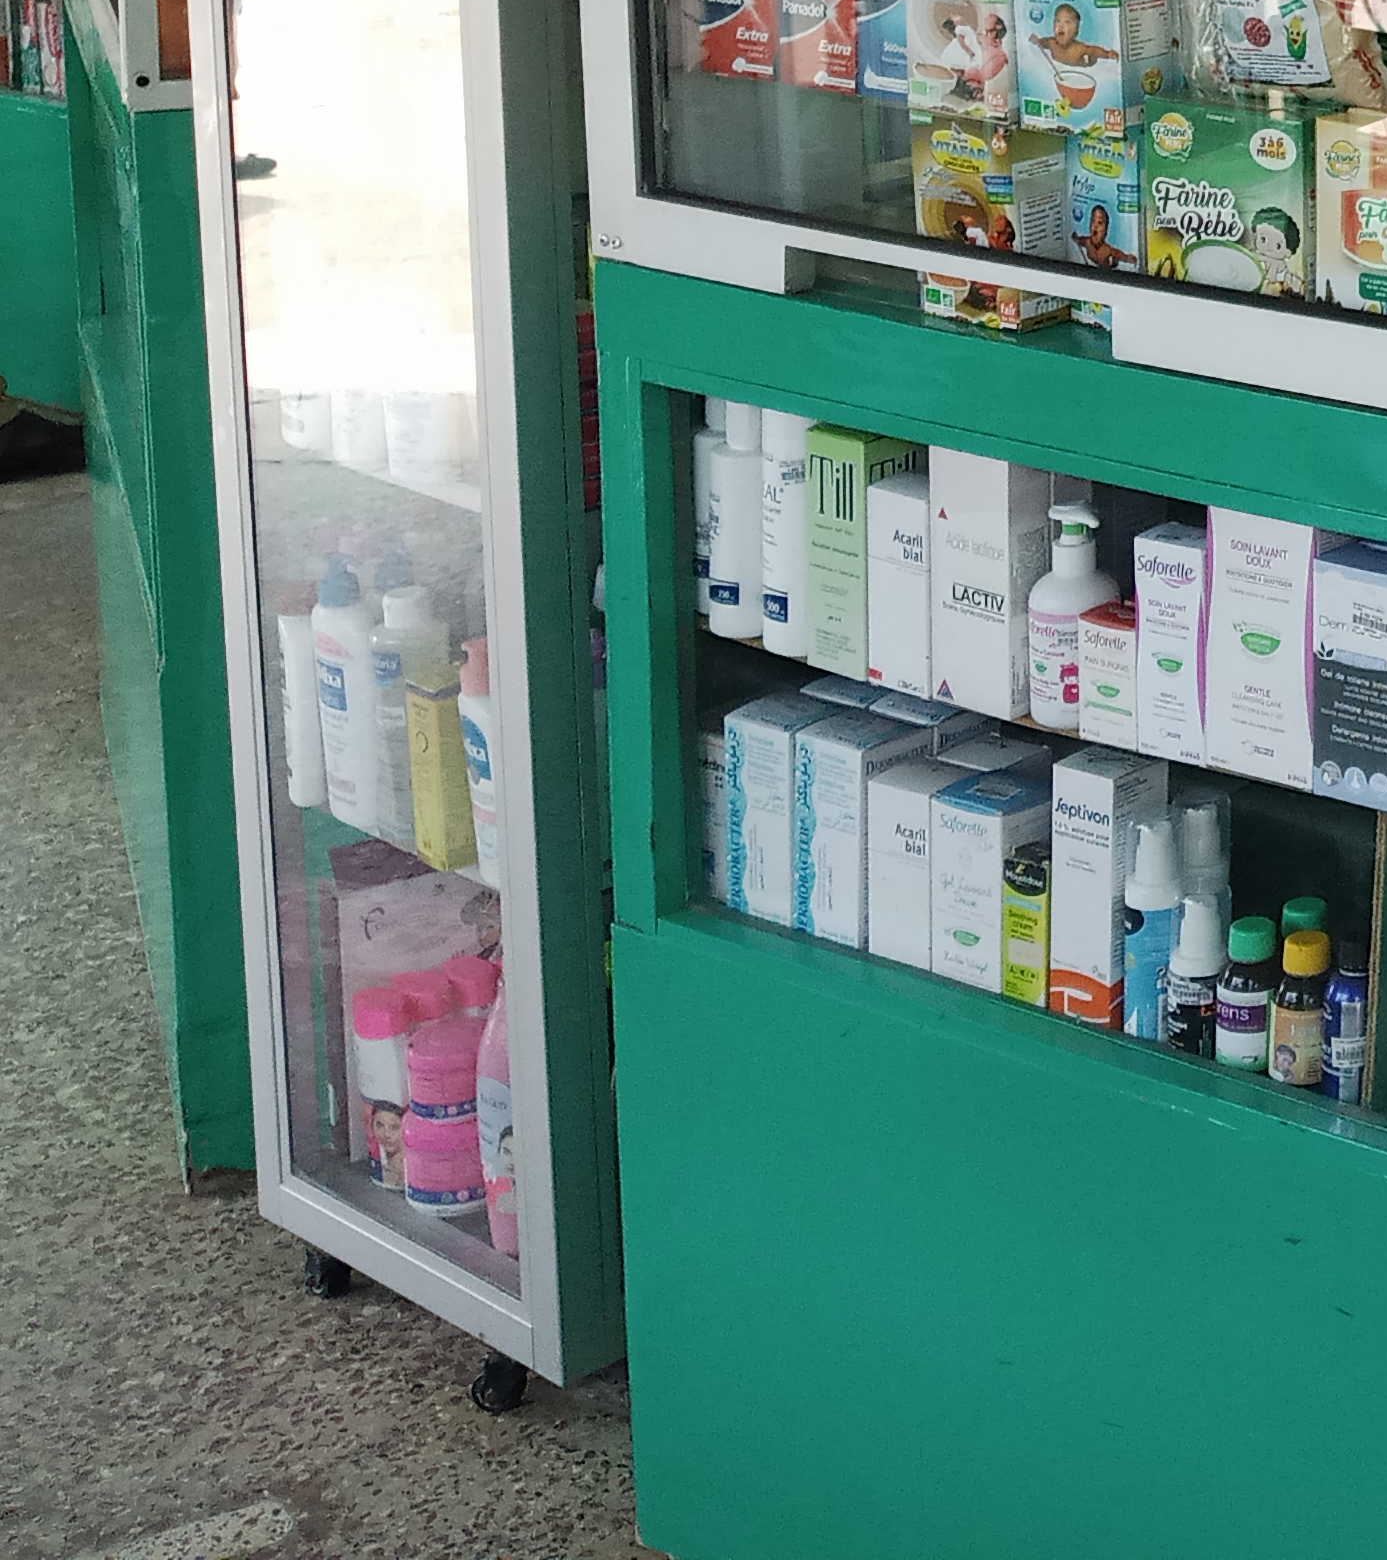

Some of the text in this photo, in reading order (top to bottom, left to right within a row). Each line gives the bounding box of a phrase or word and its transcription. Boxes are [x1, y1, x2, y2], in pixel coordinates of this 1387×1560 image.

[736, 27, 769, 43] Extra
[818, 40, 852, 56] Extra
[1105, 109, 1122, 125] fair
[1256, 147, 1288, 161] mois
[1155, 180, 1233, 213] Farine
[1155, 214, 1178, 228] pour
[1358, 230, 1378, 241] pour
[811, 454, 856, 522] Till
[893, 529, 924, 549] Acaril
[903, 547, 924, 564] bial
[1230, 540, 1288, 560] SOIN LAVANT
[1137, 555, 1195, 580] Saforelle
[1245, 556, 1272, 569] DOUX
[952, 583, 1006, 613] LACTIV
[1084, 629, 1128, 652] Saforelle
[1244, 684, 1272, 698] GENTLE
[1055, 798, 1110, 828] Septivon
[895, 823, 927, 841] Acaril
[905, 840, 927, 856] bial
